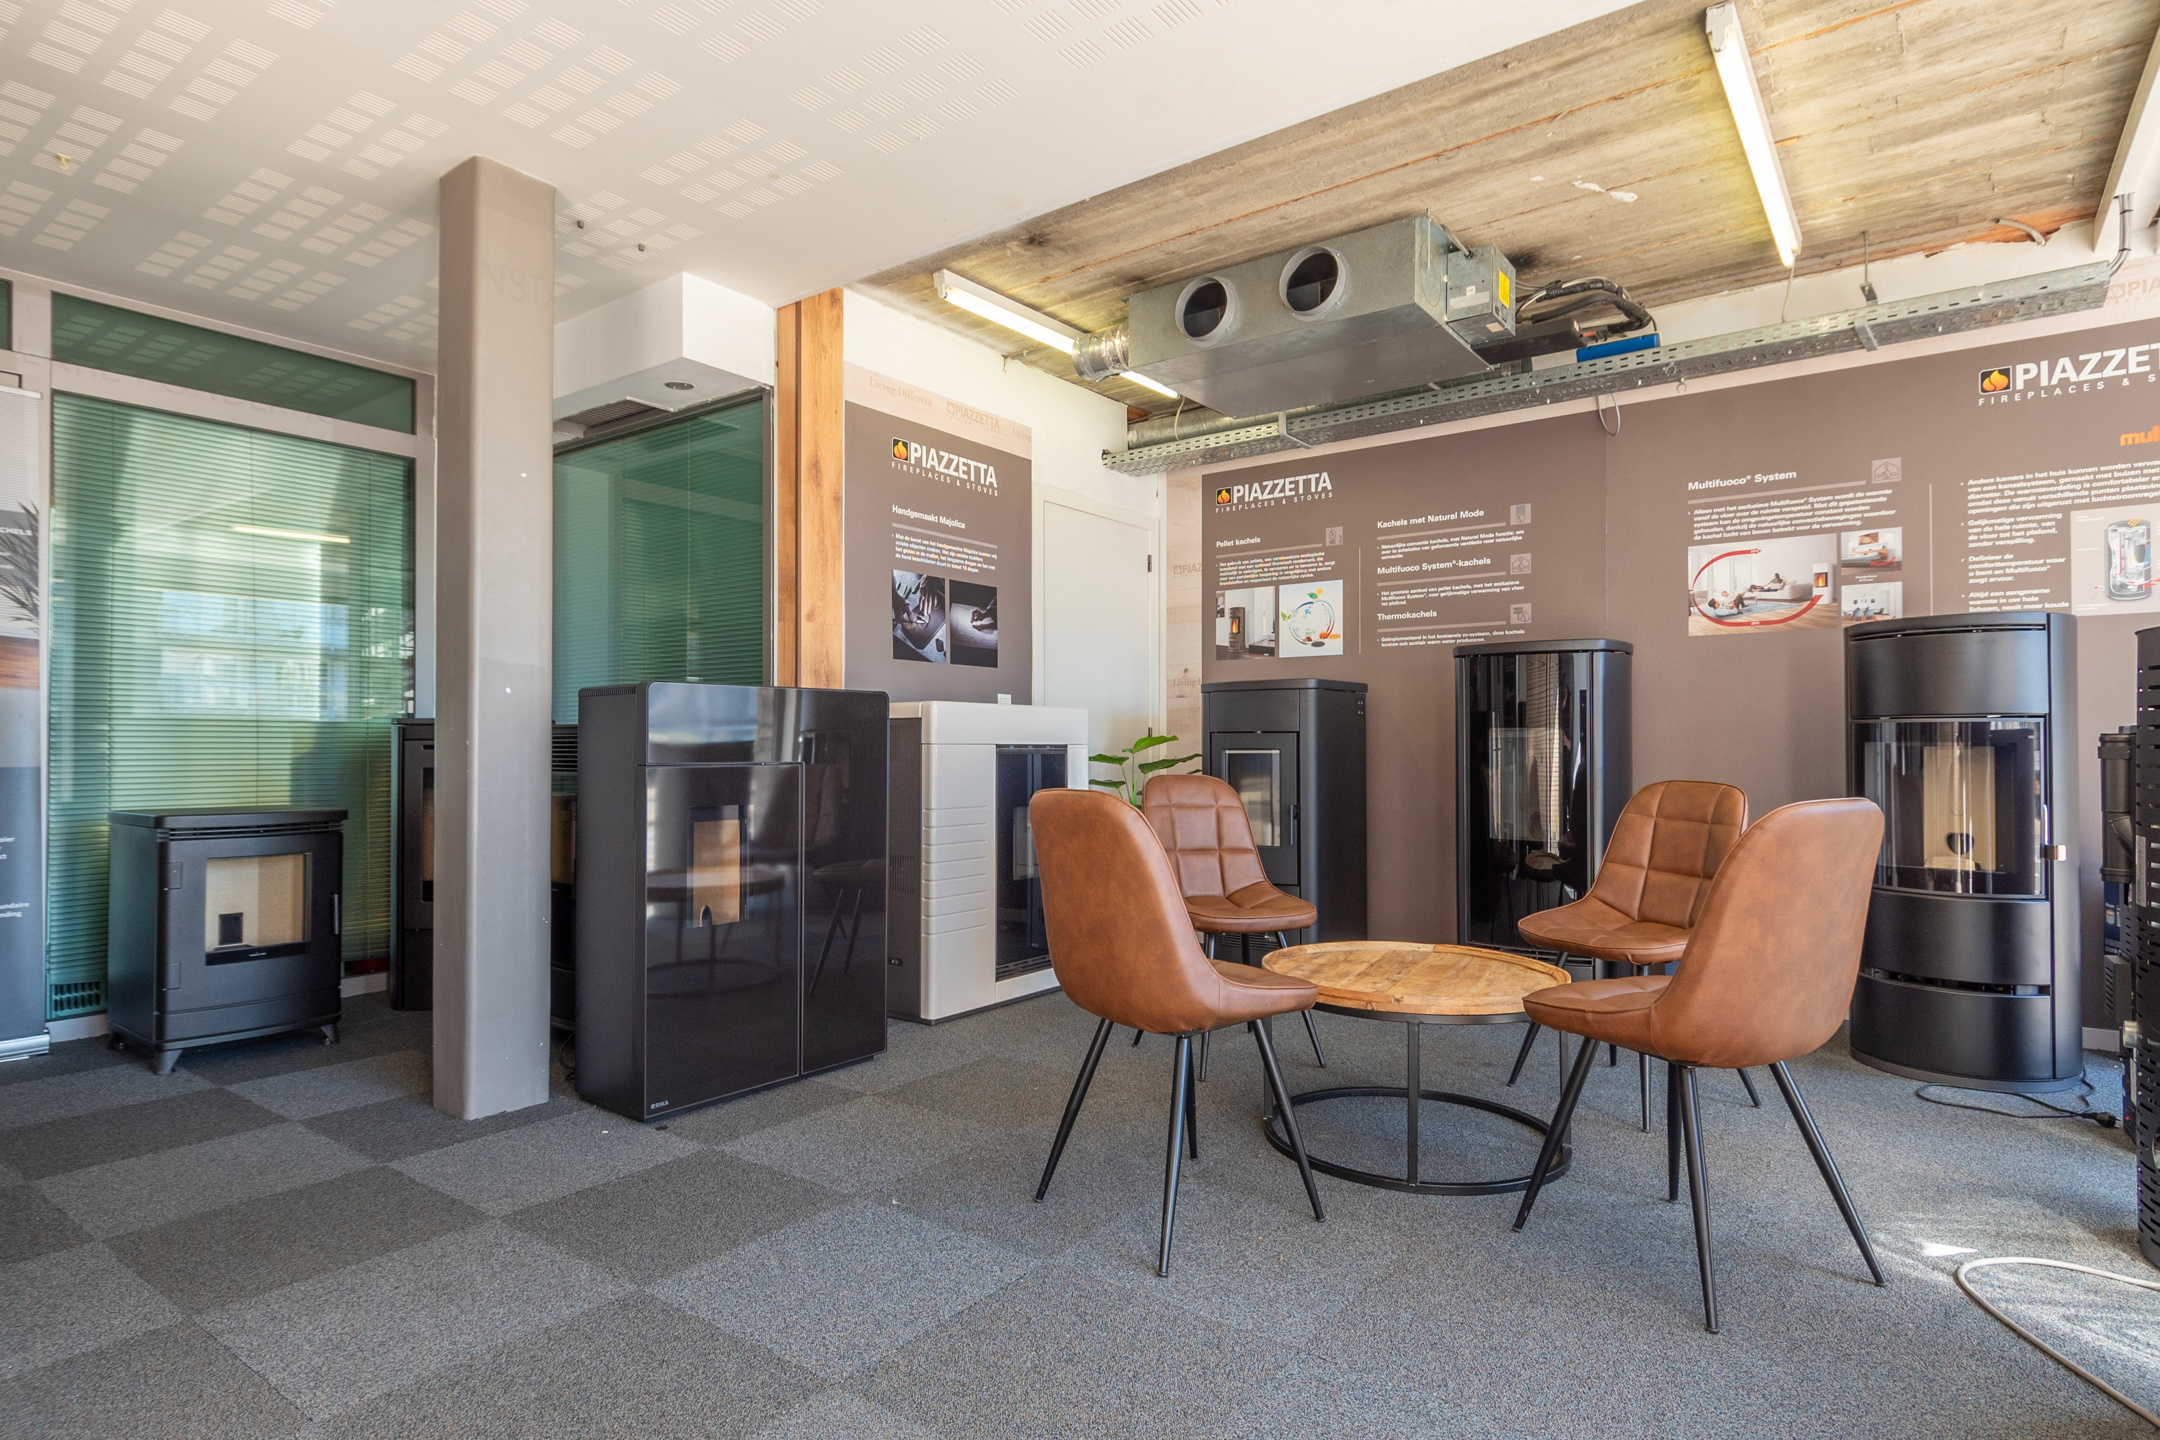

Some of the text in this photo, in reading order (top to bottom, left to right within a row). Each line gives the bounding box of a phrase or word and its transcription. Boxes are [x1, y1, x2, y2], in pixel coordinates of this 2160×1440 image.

[1979, 381, 2104, 406] FIREPLACES
[2122, 378, 2130, 386] &
[910, 442, 997, 488] PIAZZETTA
[2100, 463, 2132, 471] worden
[892, 462, 950, 483] FIREPLACES
[966, 482, 998, 496] STOVES
[1754, 471, 1797, 483] System
[2059, 474, 2094, 484] gemaakt
[1233, 472, 1332, 504] PIAZZETTA
[2091, 488, 2120, 496] punten
[2122, 483, 2160, 493] plaatsvin
[1216, 500, 1274, 513] FIREPLACES
[1294, 492, 1332, 502] STOVES
[1968, 506, 2007, 515] openingen
[2037, 499, 2072, 508] uitgerust
[892, 505, 965, 529] Handgemaakt Majolica
[1377, 509, 1484, 528] Kachels met Natural Mode
[2016, 513, 2063, 522] verwarming
[2026, 527, 2058, 537] plafond,
[1236, 537, 1260, 545] kachels
[1377, 566, 1420, 574] Multifuoco
[1377, 610, 1437, 621] Thermokachels
